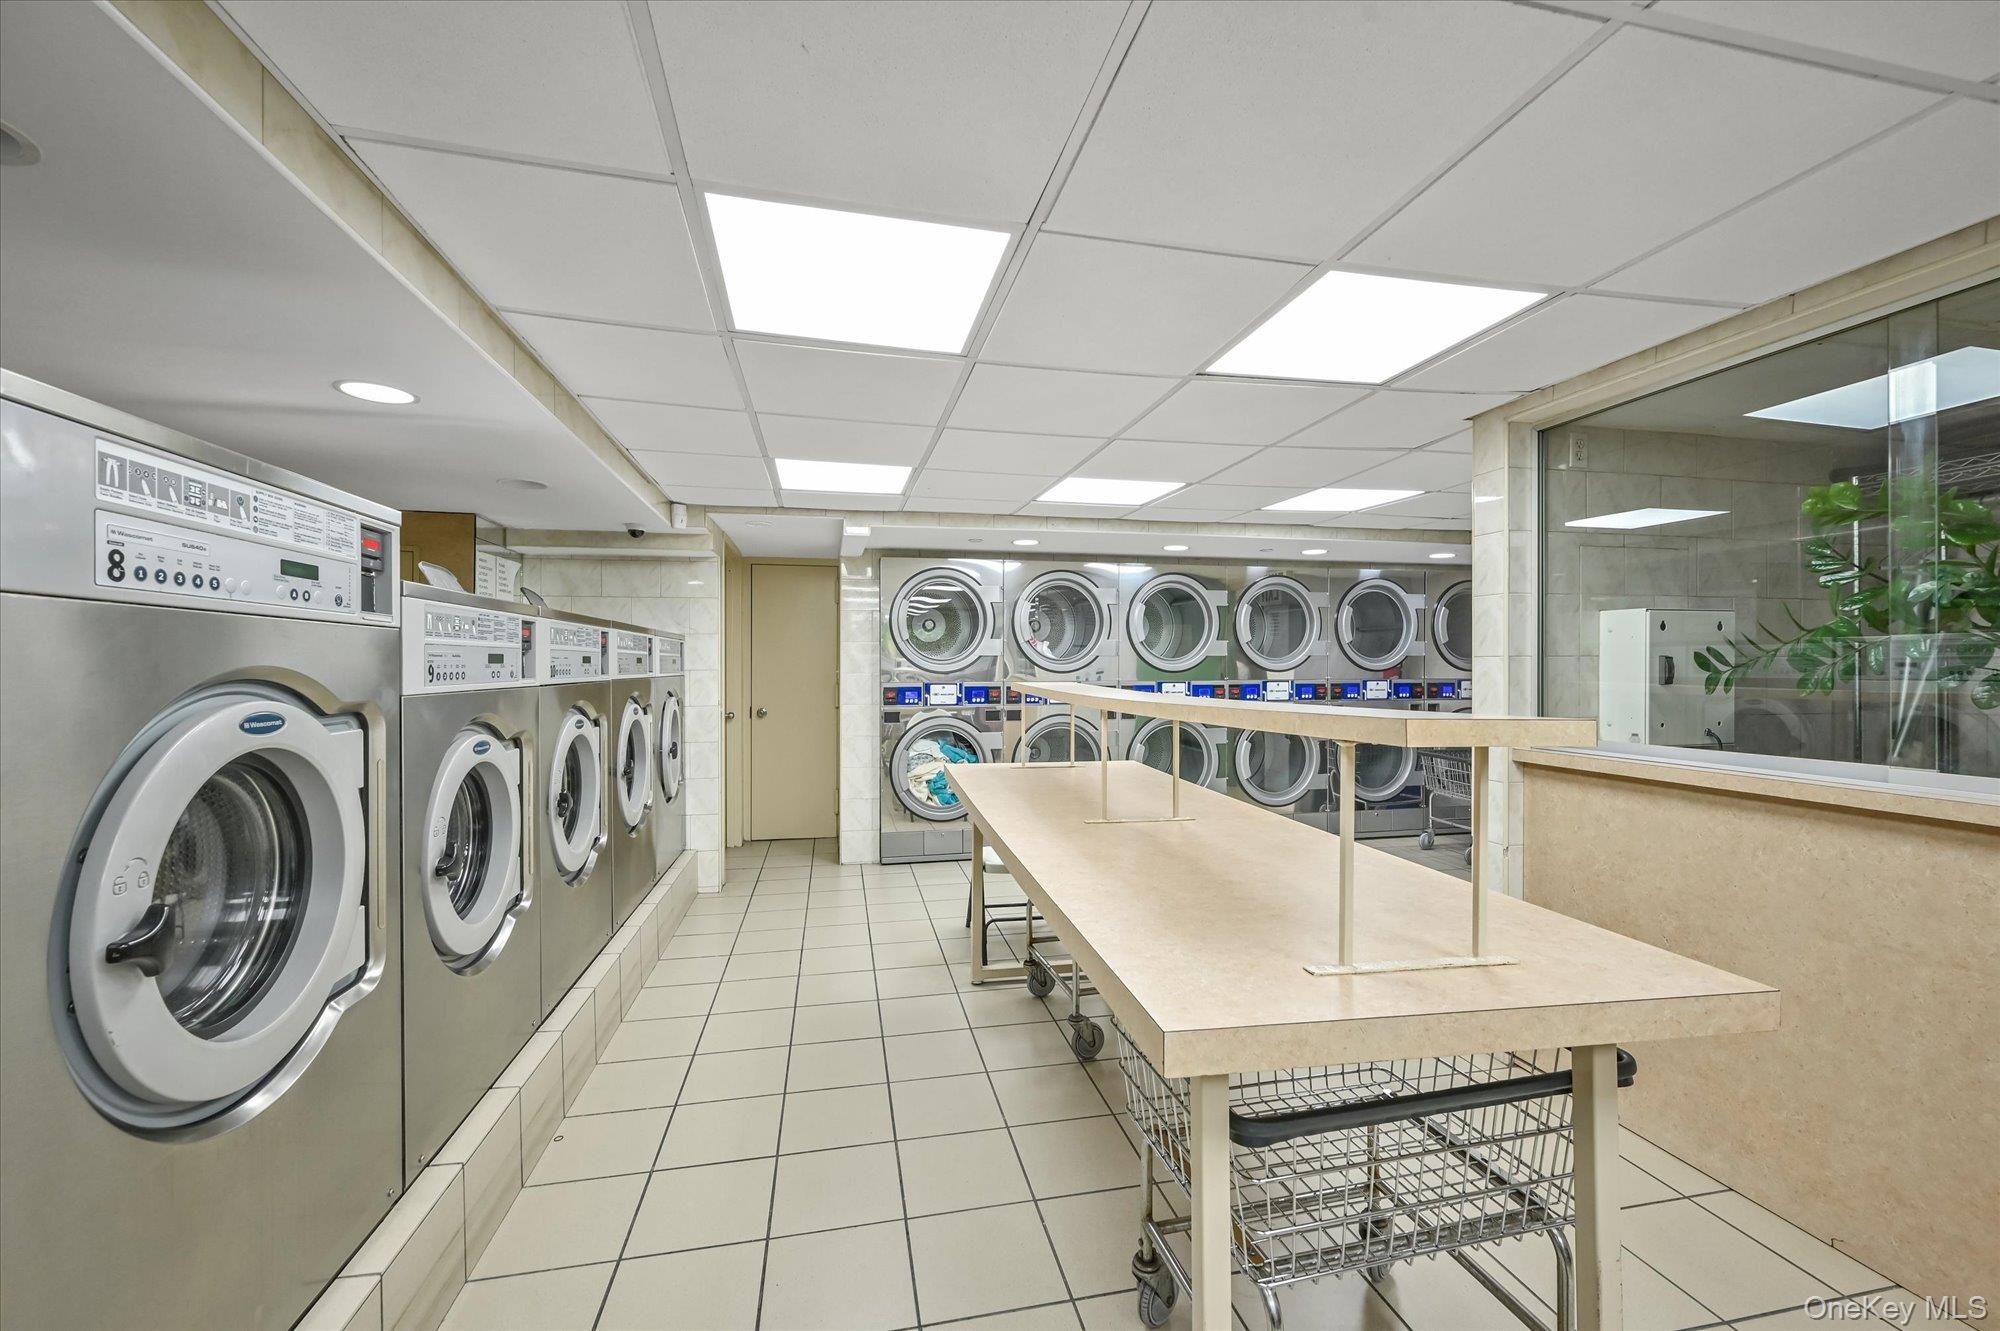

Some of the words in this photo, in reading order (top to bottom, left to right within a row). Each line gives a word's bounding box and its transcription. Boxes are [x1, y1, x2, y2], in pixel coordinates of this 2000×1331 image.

[107, 549, 125, 582] 8
[428, 664, 434, 683] 9
[250, 719, 283, 728] Wascomat
